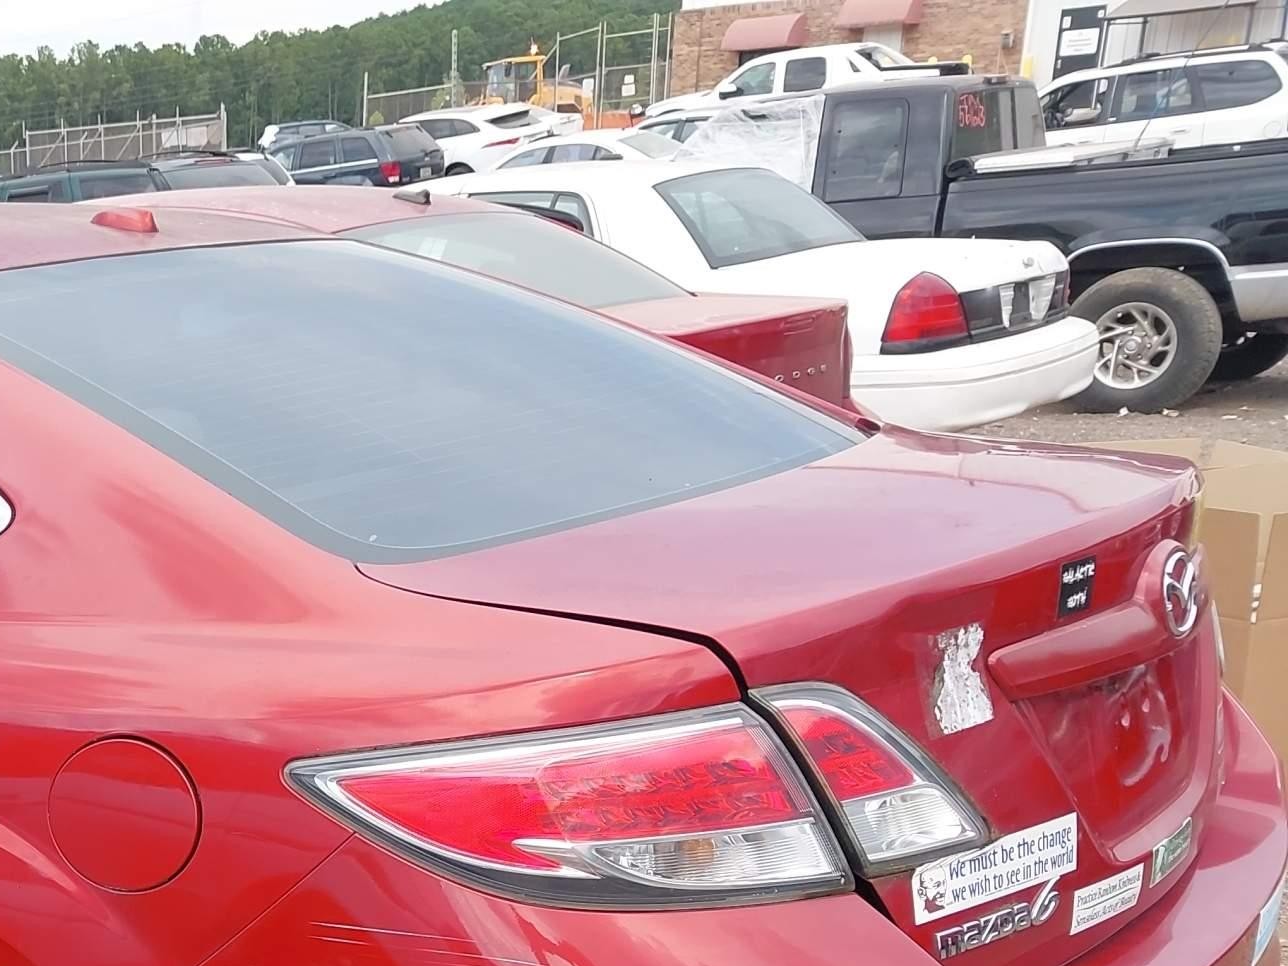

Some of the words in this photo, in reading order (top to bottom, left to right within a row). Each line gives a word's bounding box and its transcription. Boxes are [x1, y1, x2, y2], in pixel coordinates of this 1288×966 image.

[949, 861, 966, 880] We
[969, 849, 998, 875] must
[1001, 845, 1014, 864] be
[1017, 838, 1035, 859] the
[1037, 826, 1072, 851] change
[951, 886, 967, 903] we
[968, 873, 991, 899] wish
[993, 874, 1004, 893] to
[1006, 869, 1021, 886] see
[1022, 862, 1032, 880] in
[1033, 857, 1049, 877] the
[1050, 845, 1074, 871] world
